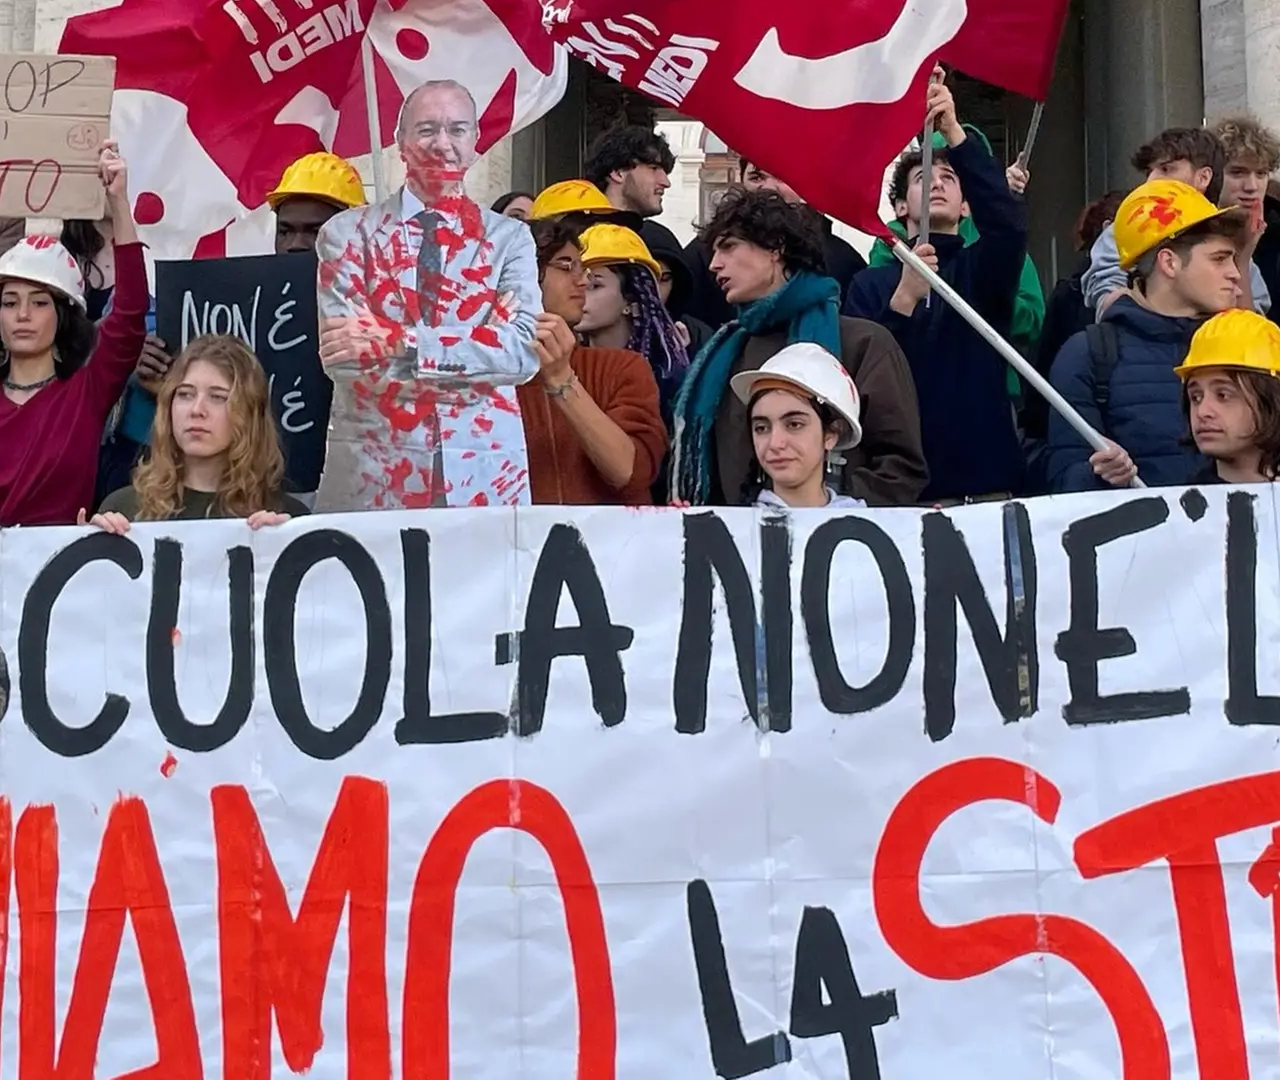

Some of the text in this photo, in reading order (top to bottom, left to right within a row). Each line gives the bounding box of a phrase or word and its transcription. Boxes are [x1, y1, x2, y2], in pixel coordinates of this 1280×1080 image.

[181, 285, 261, 353] NON
[673, 502, 1040, 742] NON
[686, 877, 899, 1080] LA
